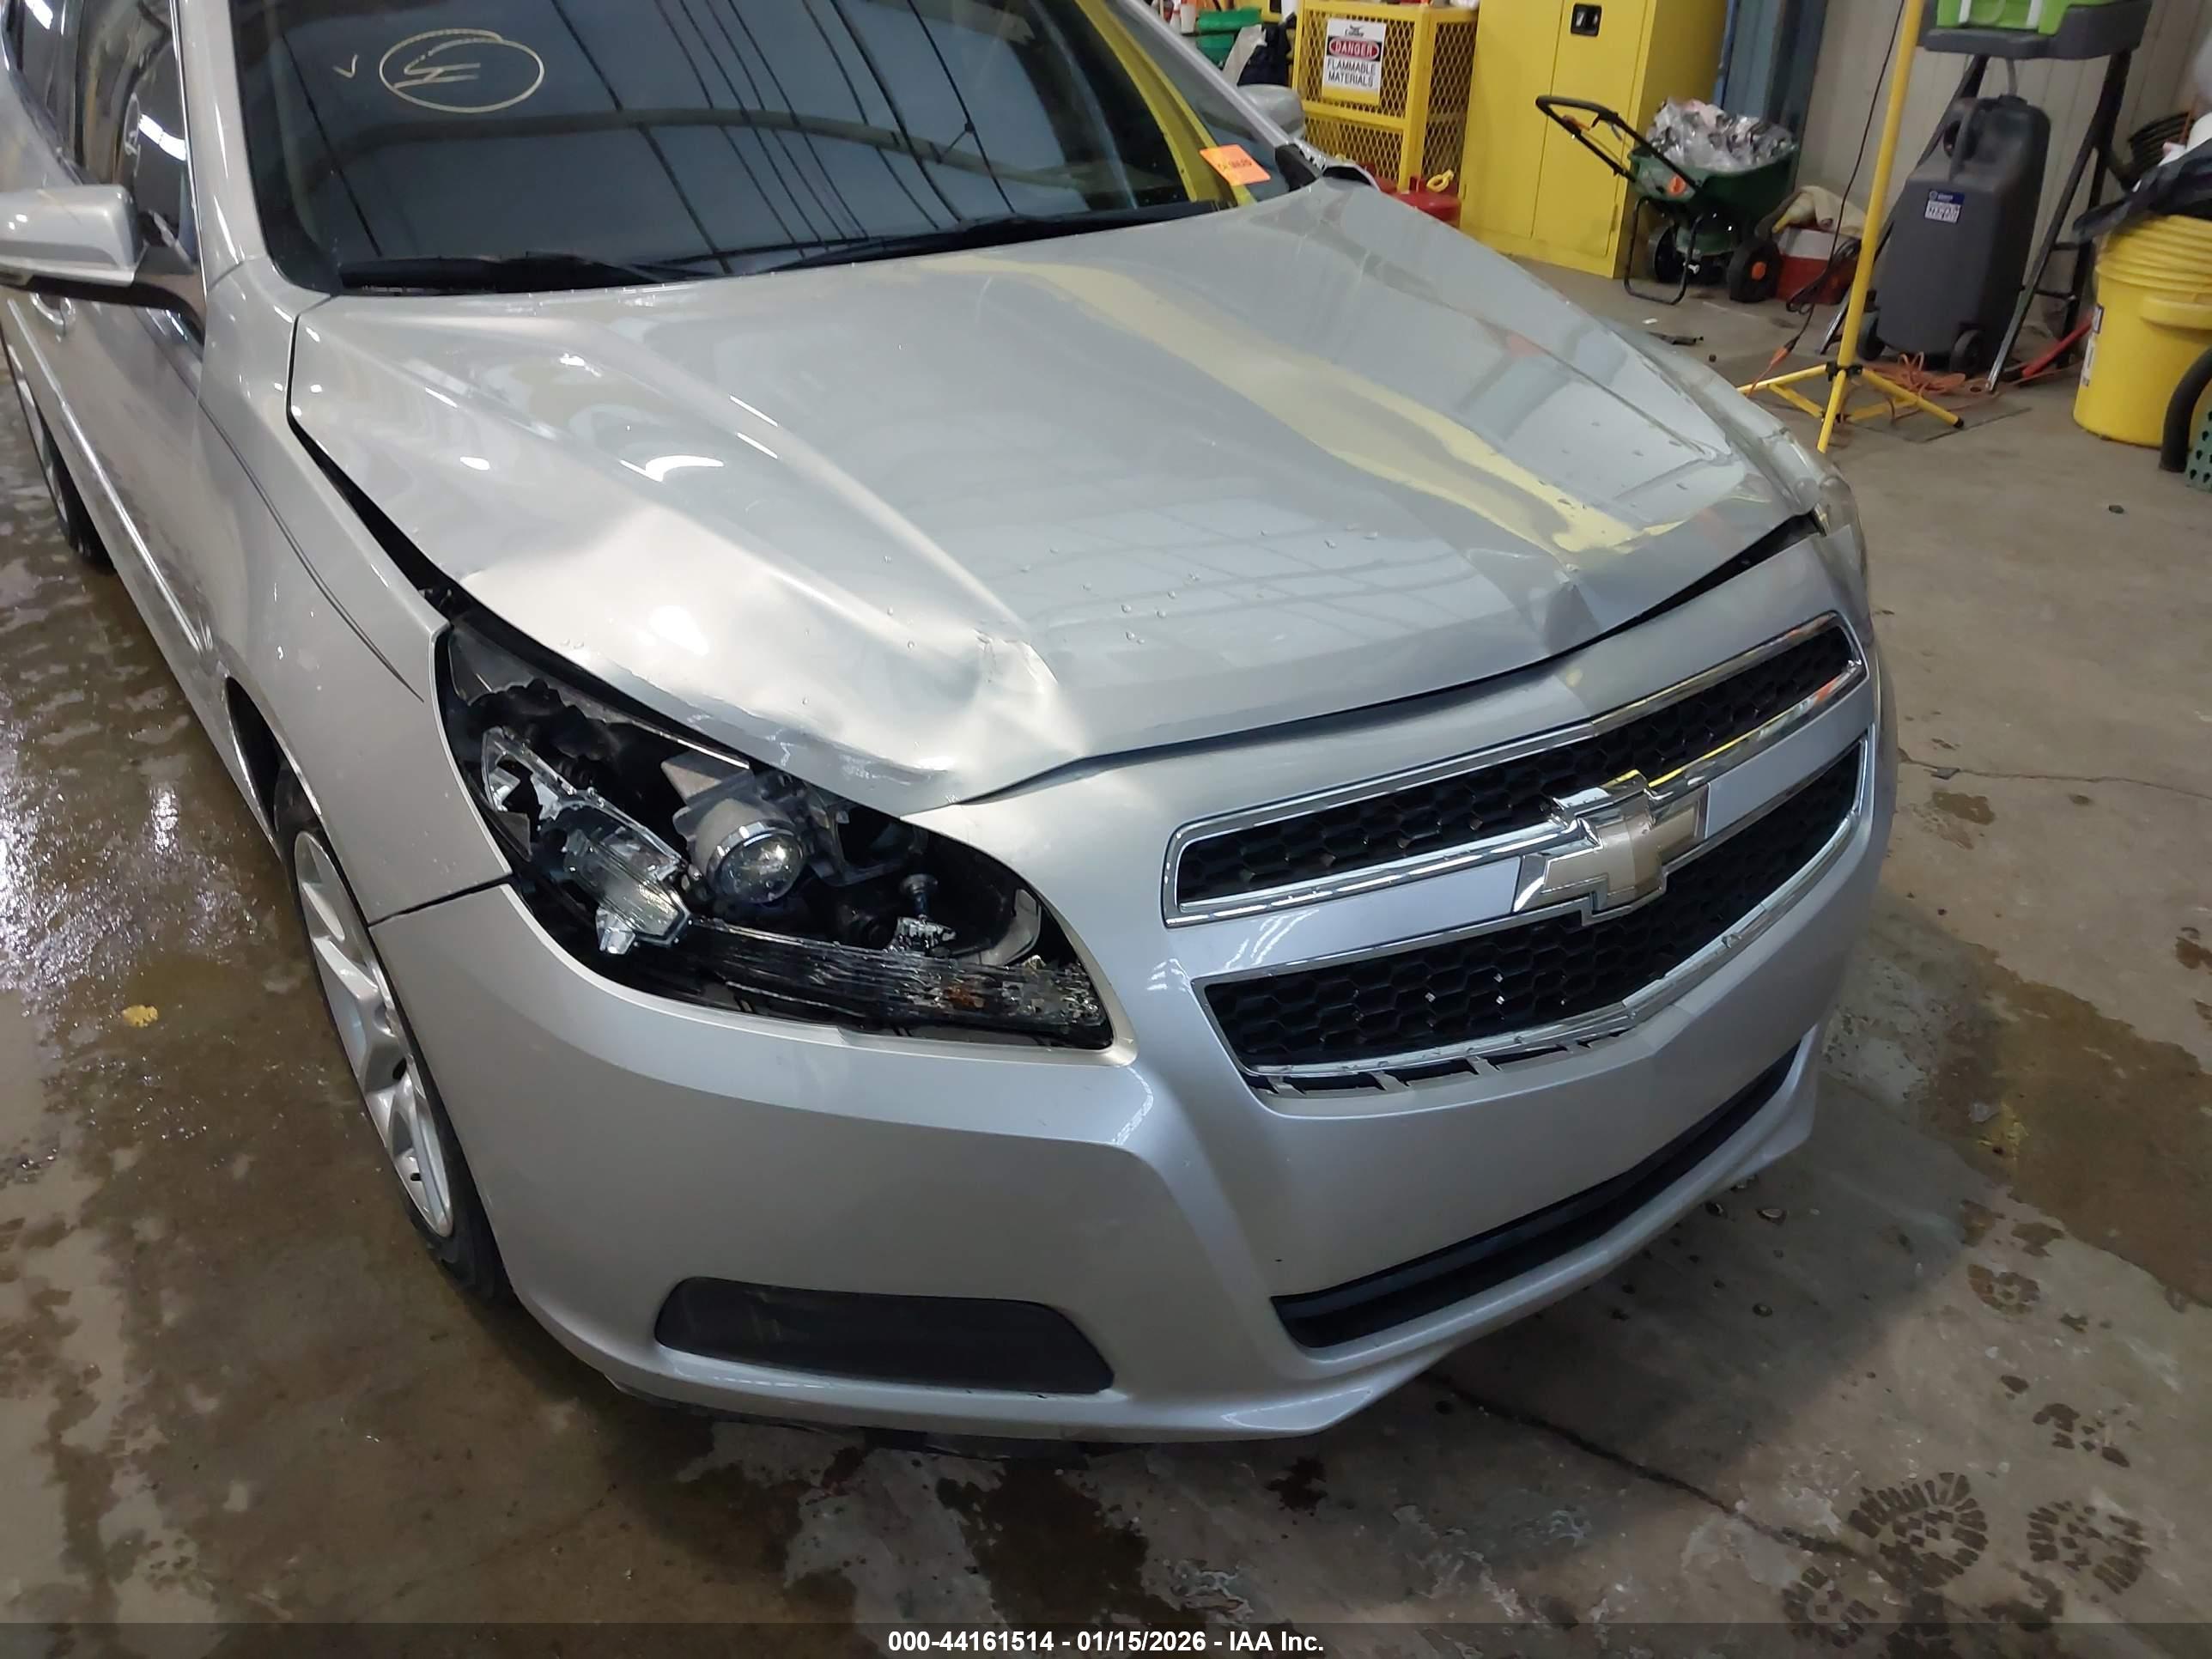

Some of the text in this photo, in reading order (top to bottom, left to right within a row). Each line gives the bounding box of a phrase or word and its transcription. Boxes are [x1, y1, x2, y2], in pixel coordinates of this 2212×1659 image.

[1334, 40, 1374, 58] DANGER
[1327, 58, 1376, 76] FLAMMABLE
[1328, 70, 1374, 88] MATERIALS
